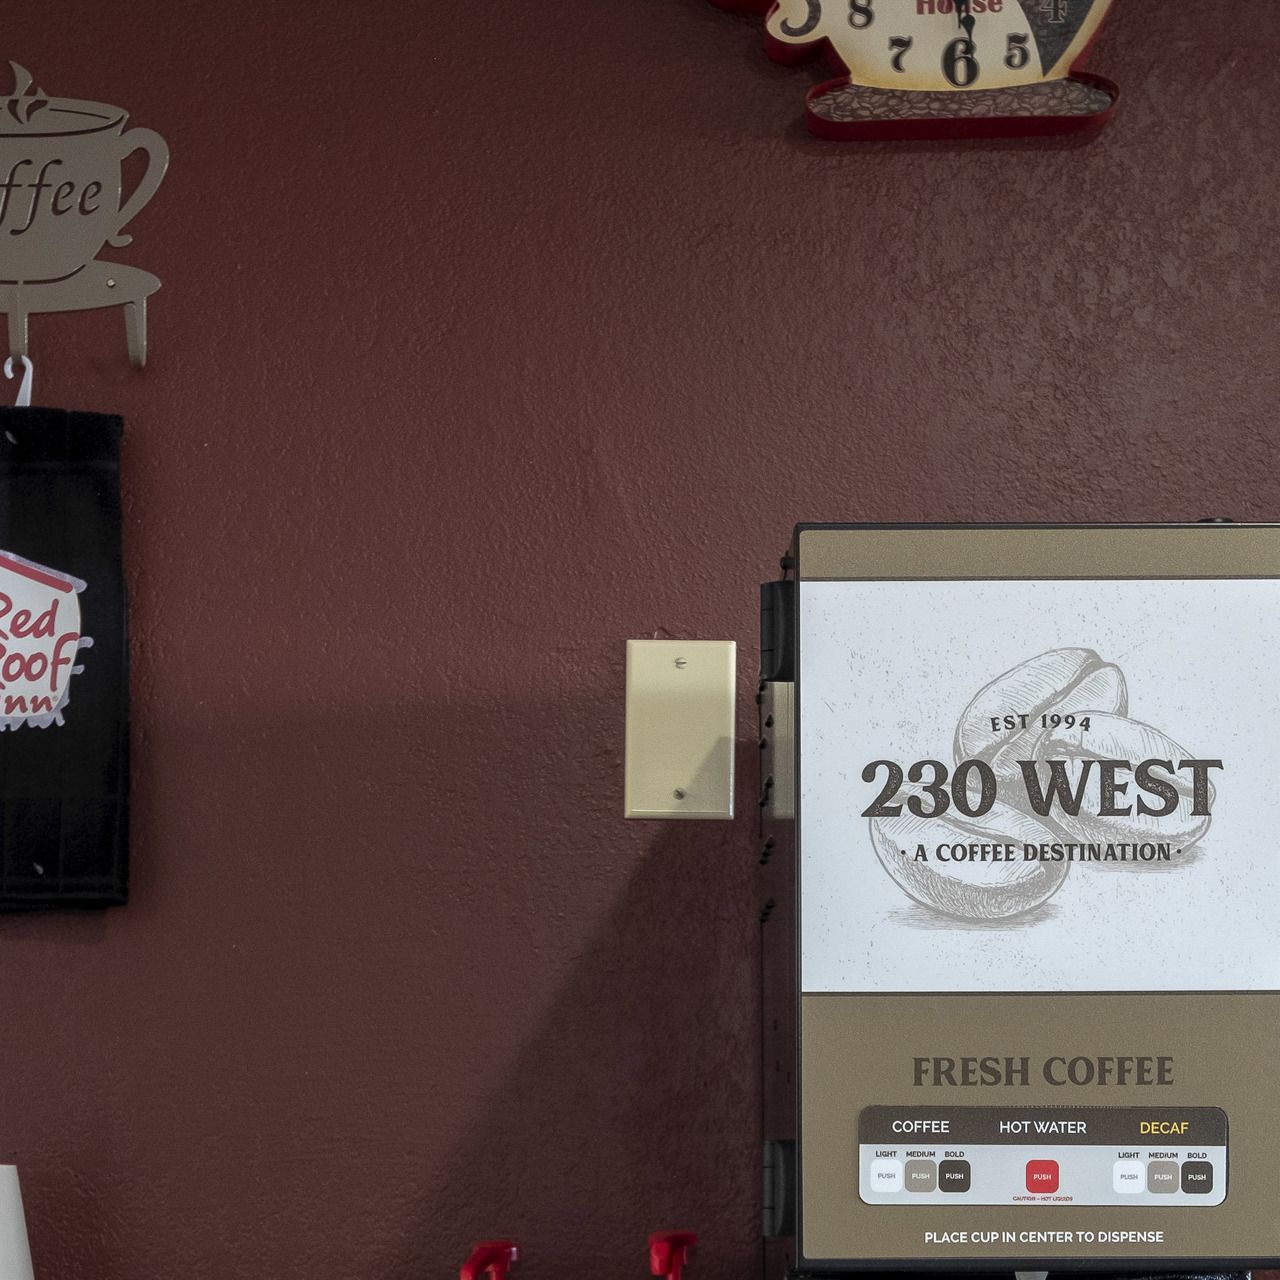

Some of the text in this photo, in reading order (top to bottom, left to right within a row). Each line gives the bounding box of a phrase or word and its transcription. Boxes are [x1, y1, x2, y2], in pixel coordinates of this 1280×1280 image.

[888, 36, 913, 73] 7
[1005, 32, 1029, 70] 5
[941, 36, 980, 88] 6
[991, 714, 1091, 731] EST 1994
[861, 759, 1224, 818] 230 WEST
[914, 843, 1171, 861] A COFFEE DESTINATION
[912, 1056, 1174, 1086] FRESH COFFEE
[892, 1120, 950, 1133] COFFEE
[1000, 1121, 1087, 1134] HOT WATER
[1140, 1122, 1189, 1134] DECAF
[924, 1232, 1164, 1243] PLACE CUP IN CENTER TO DISPENSE
